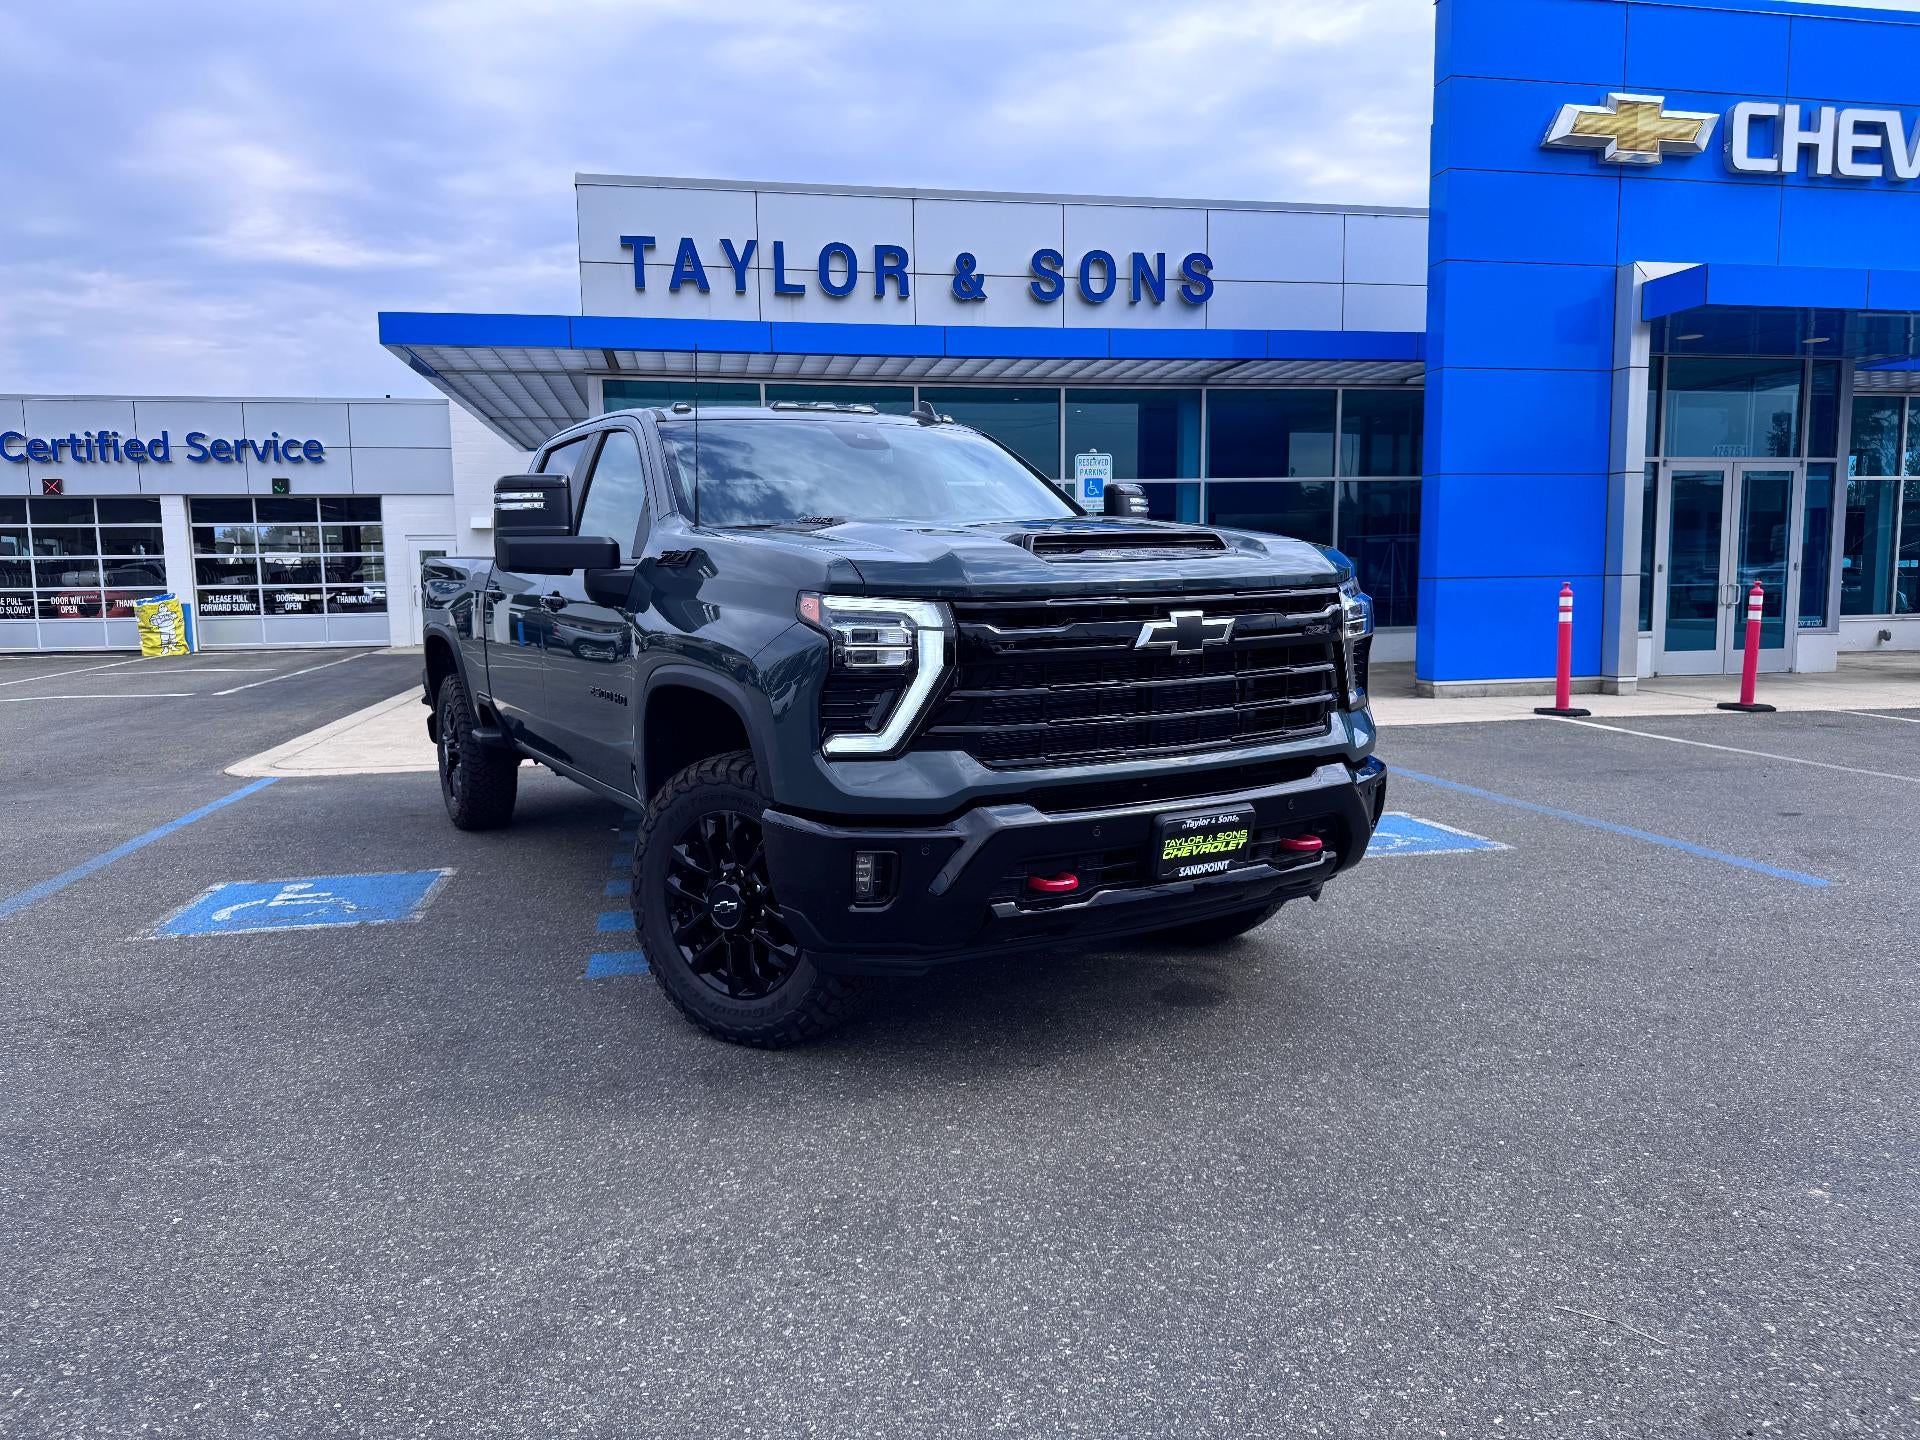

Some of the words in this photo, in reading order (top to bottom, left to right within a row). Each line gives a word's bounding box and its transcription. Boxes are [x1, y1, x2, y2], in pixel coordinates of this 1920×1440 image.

[620, 235, 911, 299] TAYLOR
[952, 252, 987, 301] &
[1030, 248, 1214, 304] SONS
[0, 431, 170, 463] Certified
[186, 431, 326, 464] Service
[1079, 458, 1108, 466] RESERVED
[7, 597, 23, 605] PULL
[51, 597, 70, 605] DOOR
[208, 595, 232, 603] PLEASE
[336, 595, 357, 603] THANK
[115, 599, 135, 608] THAN
[200, 603, 231, 612] FORWARD
[232, 603, 257, 612] SLOWLY
[285, 602, 302, 610] OPEN
[7, 606, 32, 614] SLOWLY
[60, 606, 78, 614] OPEN
[1186, 818, 1210, 829] Taylor
[1218, 815, 1237, 823] Sons
[1165, 836, 1203, 847] TAYLOR
[1206, 834, 1214, 842] &
[1217, 829, 1248, 840] SONS
[1163, 840, 1247, 859] CHEVROLET
[1179, 861, 1229, 876] SANDPOINT
